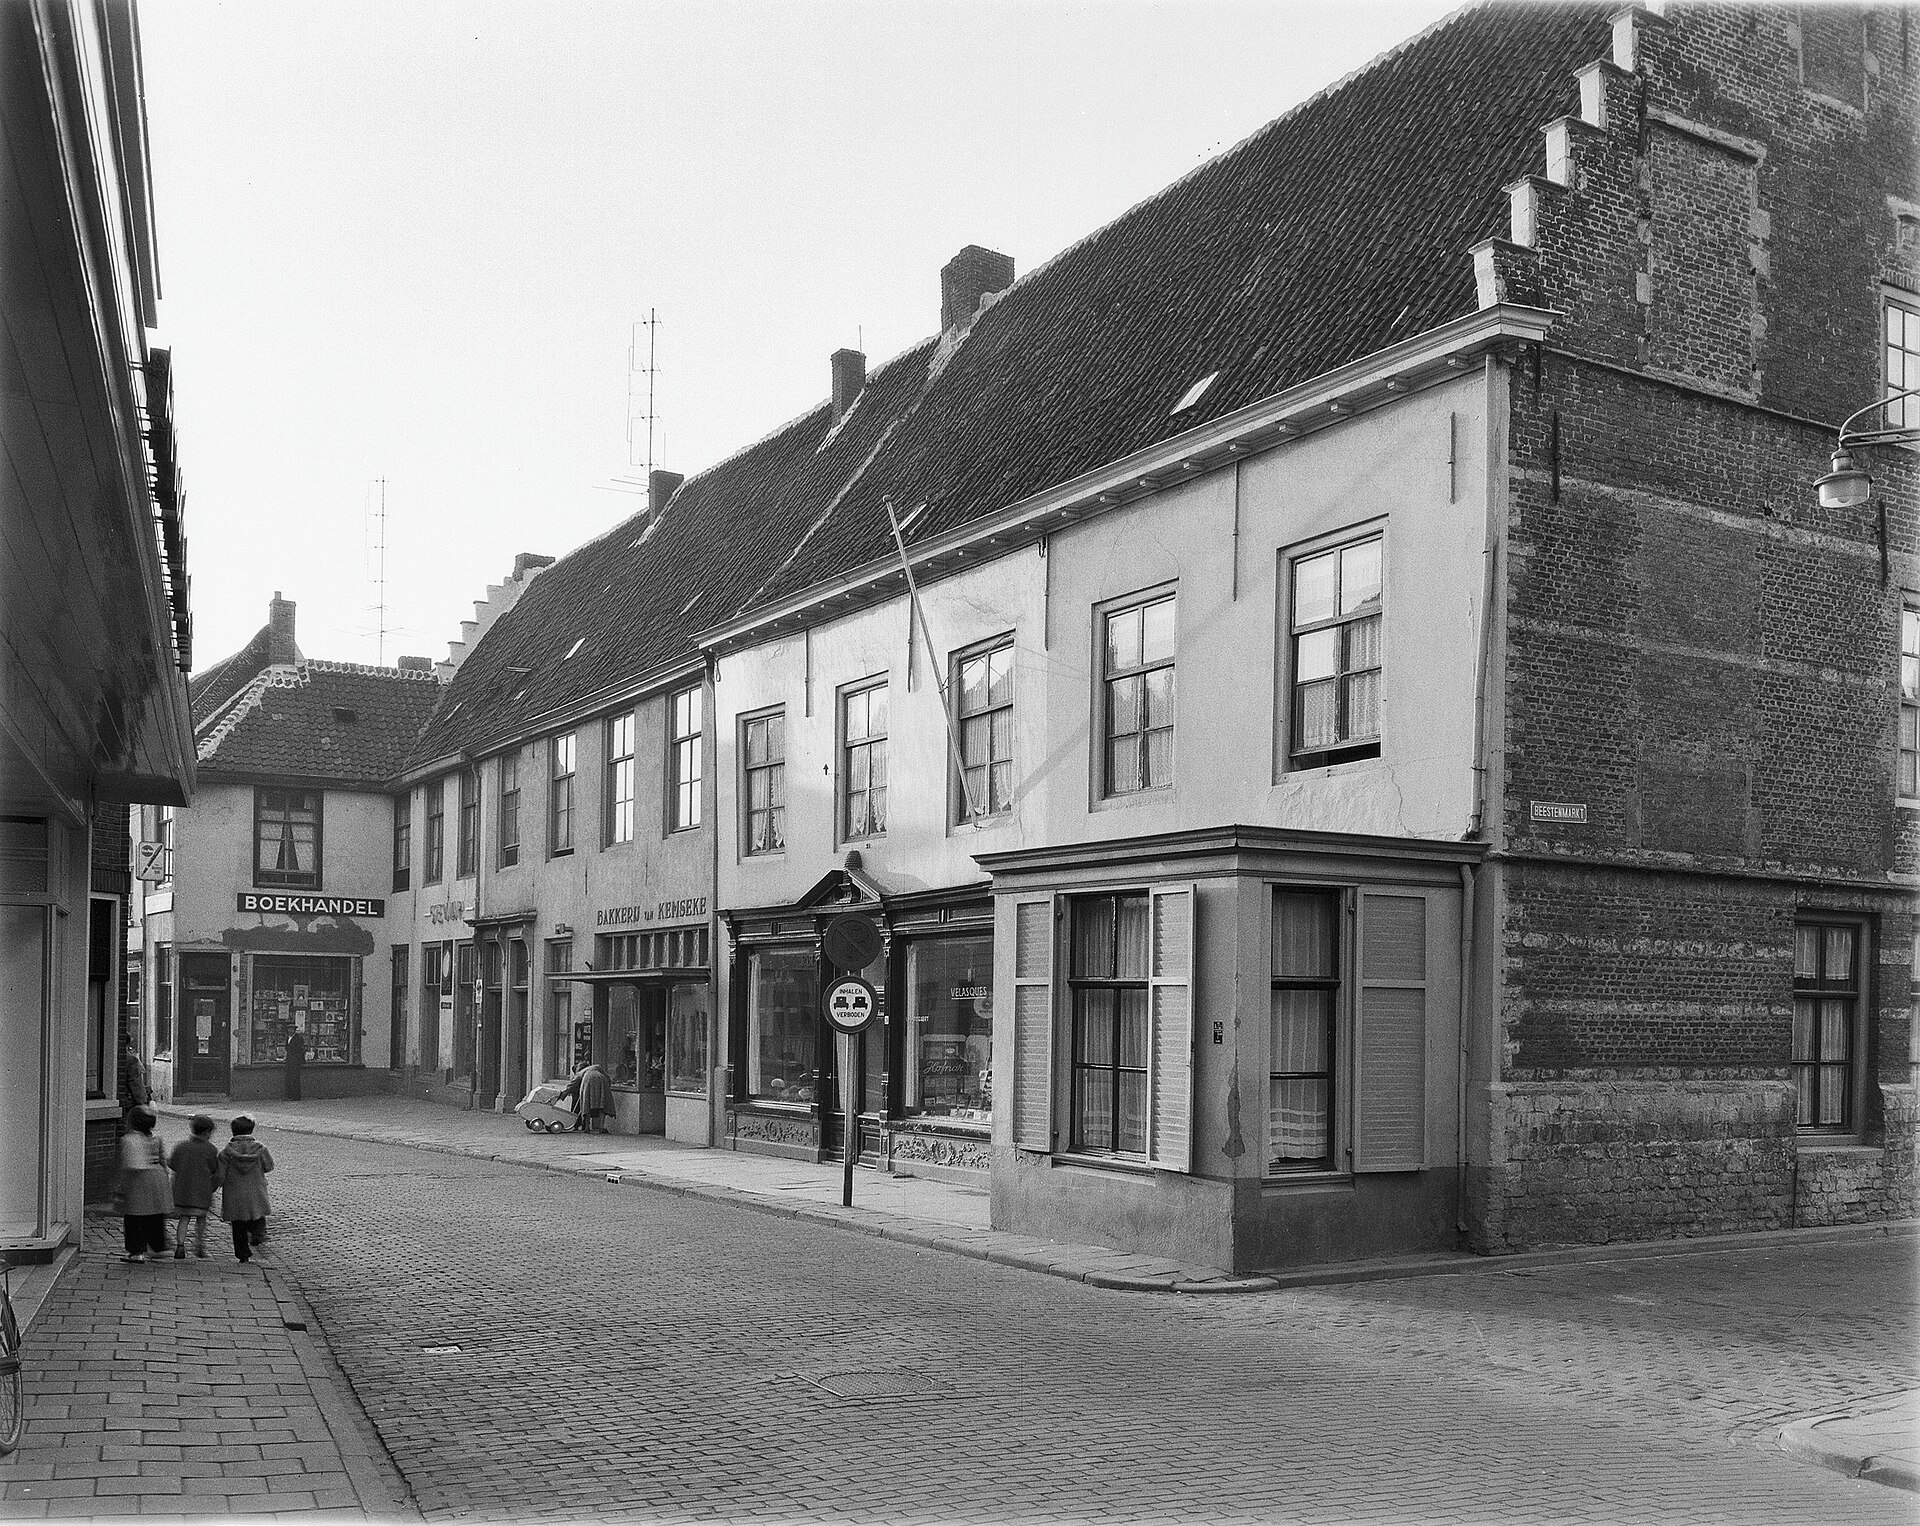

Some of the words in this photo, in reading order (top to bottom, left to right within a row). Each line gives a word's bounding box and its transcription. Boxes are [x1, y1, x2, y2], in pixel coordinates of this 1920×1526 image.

[1534, 805, 1584, 818] BEESTENMARKT
[245, 895, 378, 915] BOEKHANDEL
[597, 906, 641, 926] BAKKERIJ
[658, 897, 707, 920] KEMSEKE
[950, 986, 987, 998] VELASQUES
[923, 1060, 964, 1075] Hofnar
